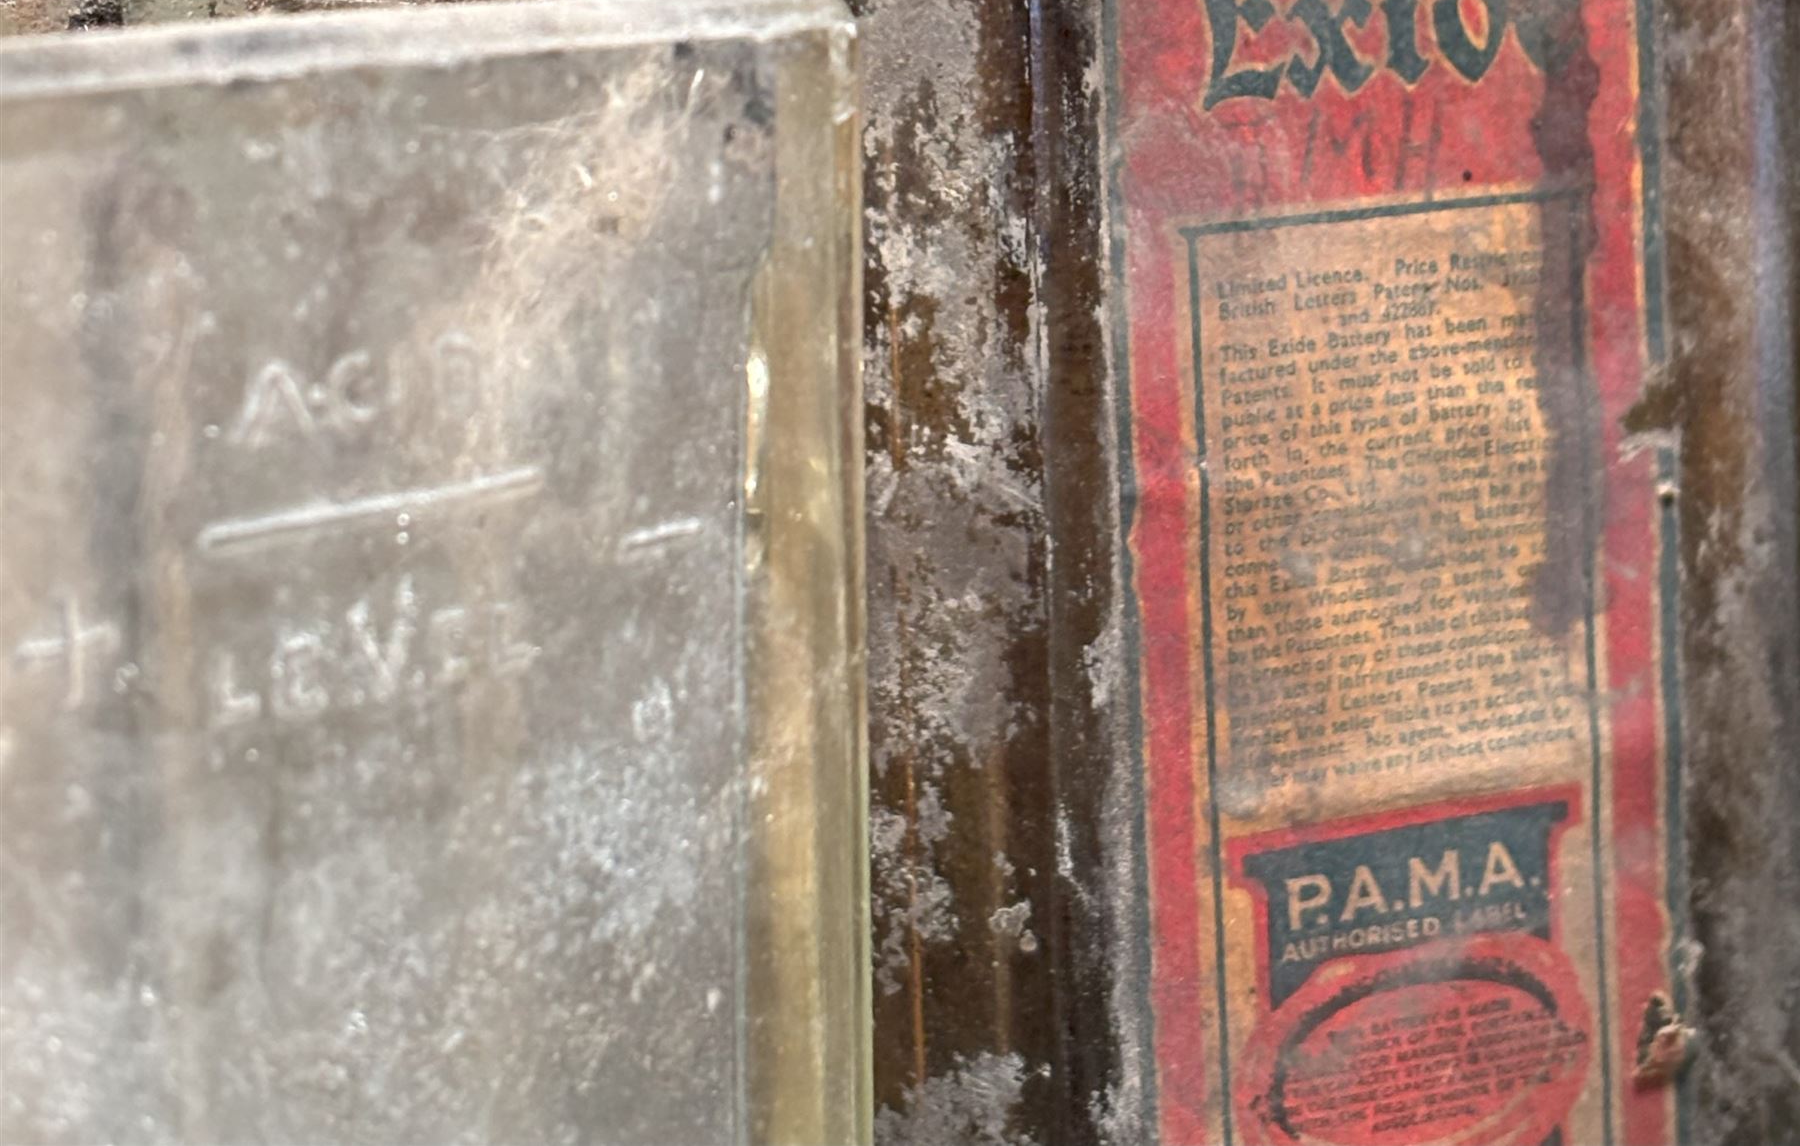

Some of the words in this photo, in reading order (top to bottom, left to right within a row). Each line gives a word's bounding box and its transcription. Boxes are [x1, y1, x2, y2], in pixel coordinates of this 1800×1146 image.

[1394, 257, 1438, 276] Price
[1218, 296, 1274, 320] British
[1294, 290, 1356, 309] Letters
[1338, 311, 1370, 326] and
[1219, 342, 1257, 362] This
[1267, 335, 1316, 356] Exide
[1327, 327, 1390, 347] Battery
[1404, 323, 1432, 339] has
[1444, 318, 1487, 334] been
[1219, 358, 1296, 385] factured
[1307, 355, 1359, 374] under
[1368, 348, 1398, 365] the
[1338, 372, 1382, 390] must
[1389, 369, 1418, 384] not
[1430, 363, 1452, 378] be
[1463, 356, 1496, 374] sold
[1503, 356, 1520, 369] to
[1221, 408, 1275, 431] public
[1284, 404, 1303, 420] at
[1311, 403, 1320, 416] a
[1328, 396, 1374, 415] price
[1383, 391, 1415, 406] less
[1427, 384, 1466, 400] than
[1476, 378, 1505, 396] the
[1222, 435, 1269, 450] price
[1279, 423, 1298, 441] of
[1310, 419, 1341, 437] this
[1350, 418, 1390, 433] type
[1400, 408, 1418, 425] of
[1429, 402, 1490, 419] battery
[1223, 449, 1270, 470] forth
[1319, 441, 1348, 457] the
[1365, 429, 1432, 452] current
[1444, 425, 1490, 442] price
[1224, 476, 1254, 492] the
[1364, 453, 1397, 472] The
[1224, 494, 1293, 511] Storage
[1225, 519, 1243, 535] or
[1252, 513, 1300, 531] other
[1438, 486, 1479, 504] must
[1489, 482, 1511, 498] be
[1224, 542, 1244, 556] to
[1259, 535, 1289, 551] the
[1224, 580, 1258, 598] this
[1226, 605, 1246, 621] by
[1261, 600, 1291, 613] any
[1453, 570, 1503, 586] terms
[1226, 624, 1267, 643] than
[1274, 618, 1323, 636] those
[1429, 592, 1456, 610] for
[1227, 647, 1247, 662] by
[1252, 642, 1282, 660] the
[1381, 622, 1411, 638] The
[1414, 615, 1446, 634] sale
[1450, 610, 1467, 630] of
[1314, 653, 1333, 671] of
[1339, 652, 1366, 668] any
[1374, 643, 1392, 661] of
[1396, 642, 1443, 658] these
[1314, 674, 1332, 693] of
[1455, 652, 1473, 670] of
[1340, 689, 1401, 710] Letters
[1417, 675, 1473, 698] Patent
[1331, 713, 1376, 733] seller
[1383, 703, 1430, 723] liable
[1457, 697, 1479, 712] an
[1366, 730, 1393, 746] No
[1437, 742, 1484, 759] these
[1281, 916, 1441, 964] AUTHORISED
[1454, 900, 1528, 929] LABEL
[1406, 1029, 1429, 1045] OF
[1434, 1023, 1463, 1039] THE
